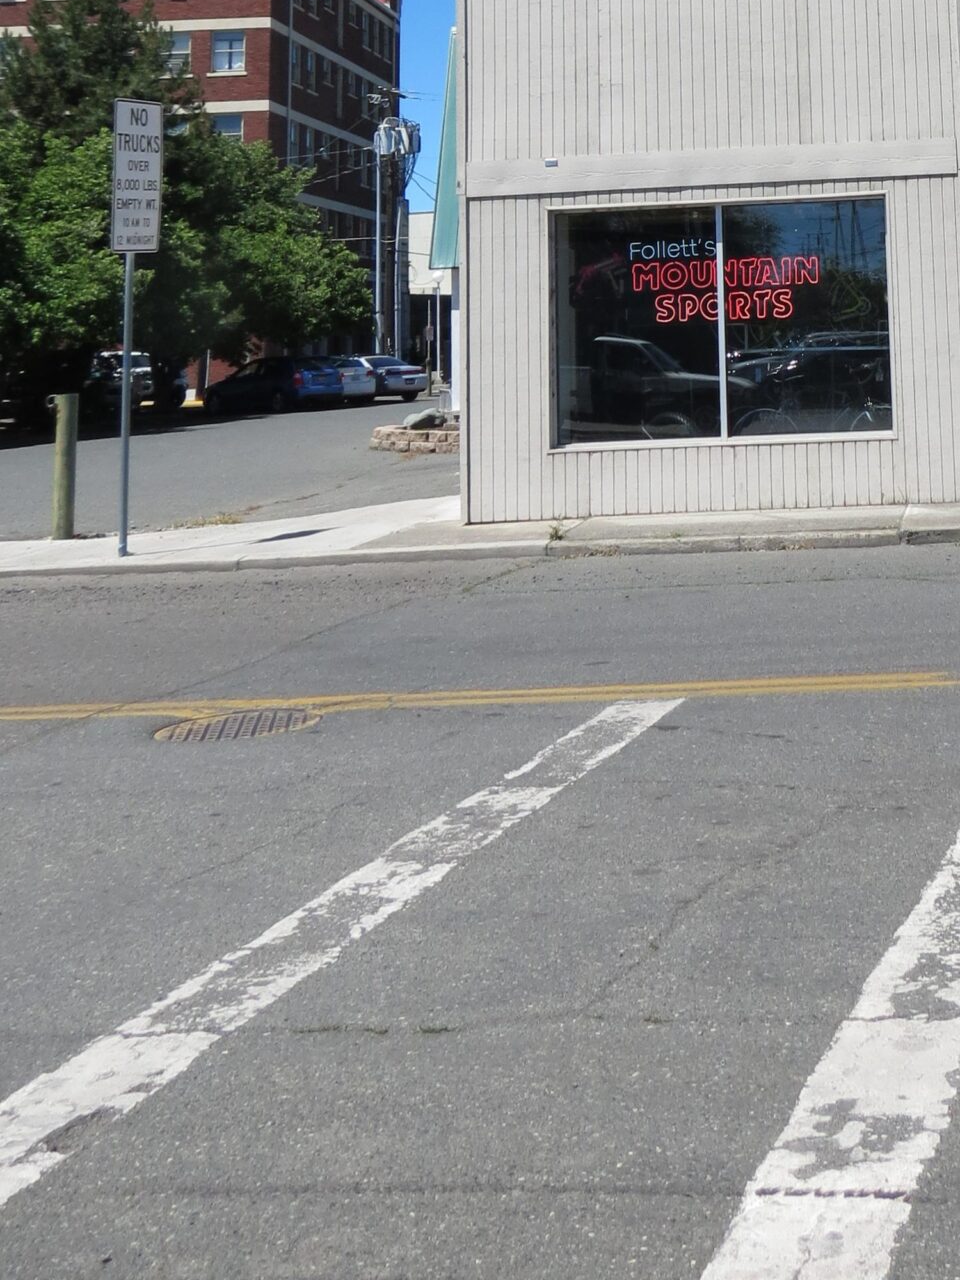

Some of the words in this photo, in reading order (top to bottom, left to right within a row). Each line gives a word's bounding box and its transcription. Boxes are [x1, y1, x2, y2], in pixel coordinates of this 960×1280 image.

[130, 108, 148, 127] NO
[117, 133, 160, 153] TRUCKS
[128, 160, 149, 171] OVER
[117, 179, 140, 192] 8,000
[143, 180, 159, 192] LBS.
[117, 199, 141, 210] EMPTY
[146, 199, 158, 210] WT.
[143, 218, 150, 227] TO
[126, 235, 154, 246] MIDNIGHT
[629, 238, 717, 260] Follett's
[632, 256, 820, 291] MOUNTAIN
[655, 289, 794, 323] SPORTS
